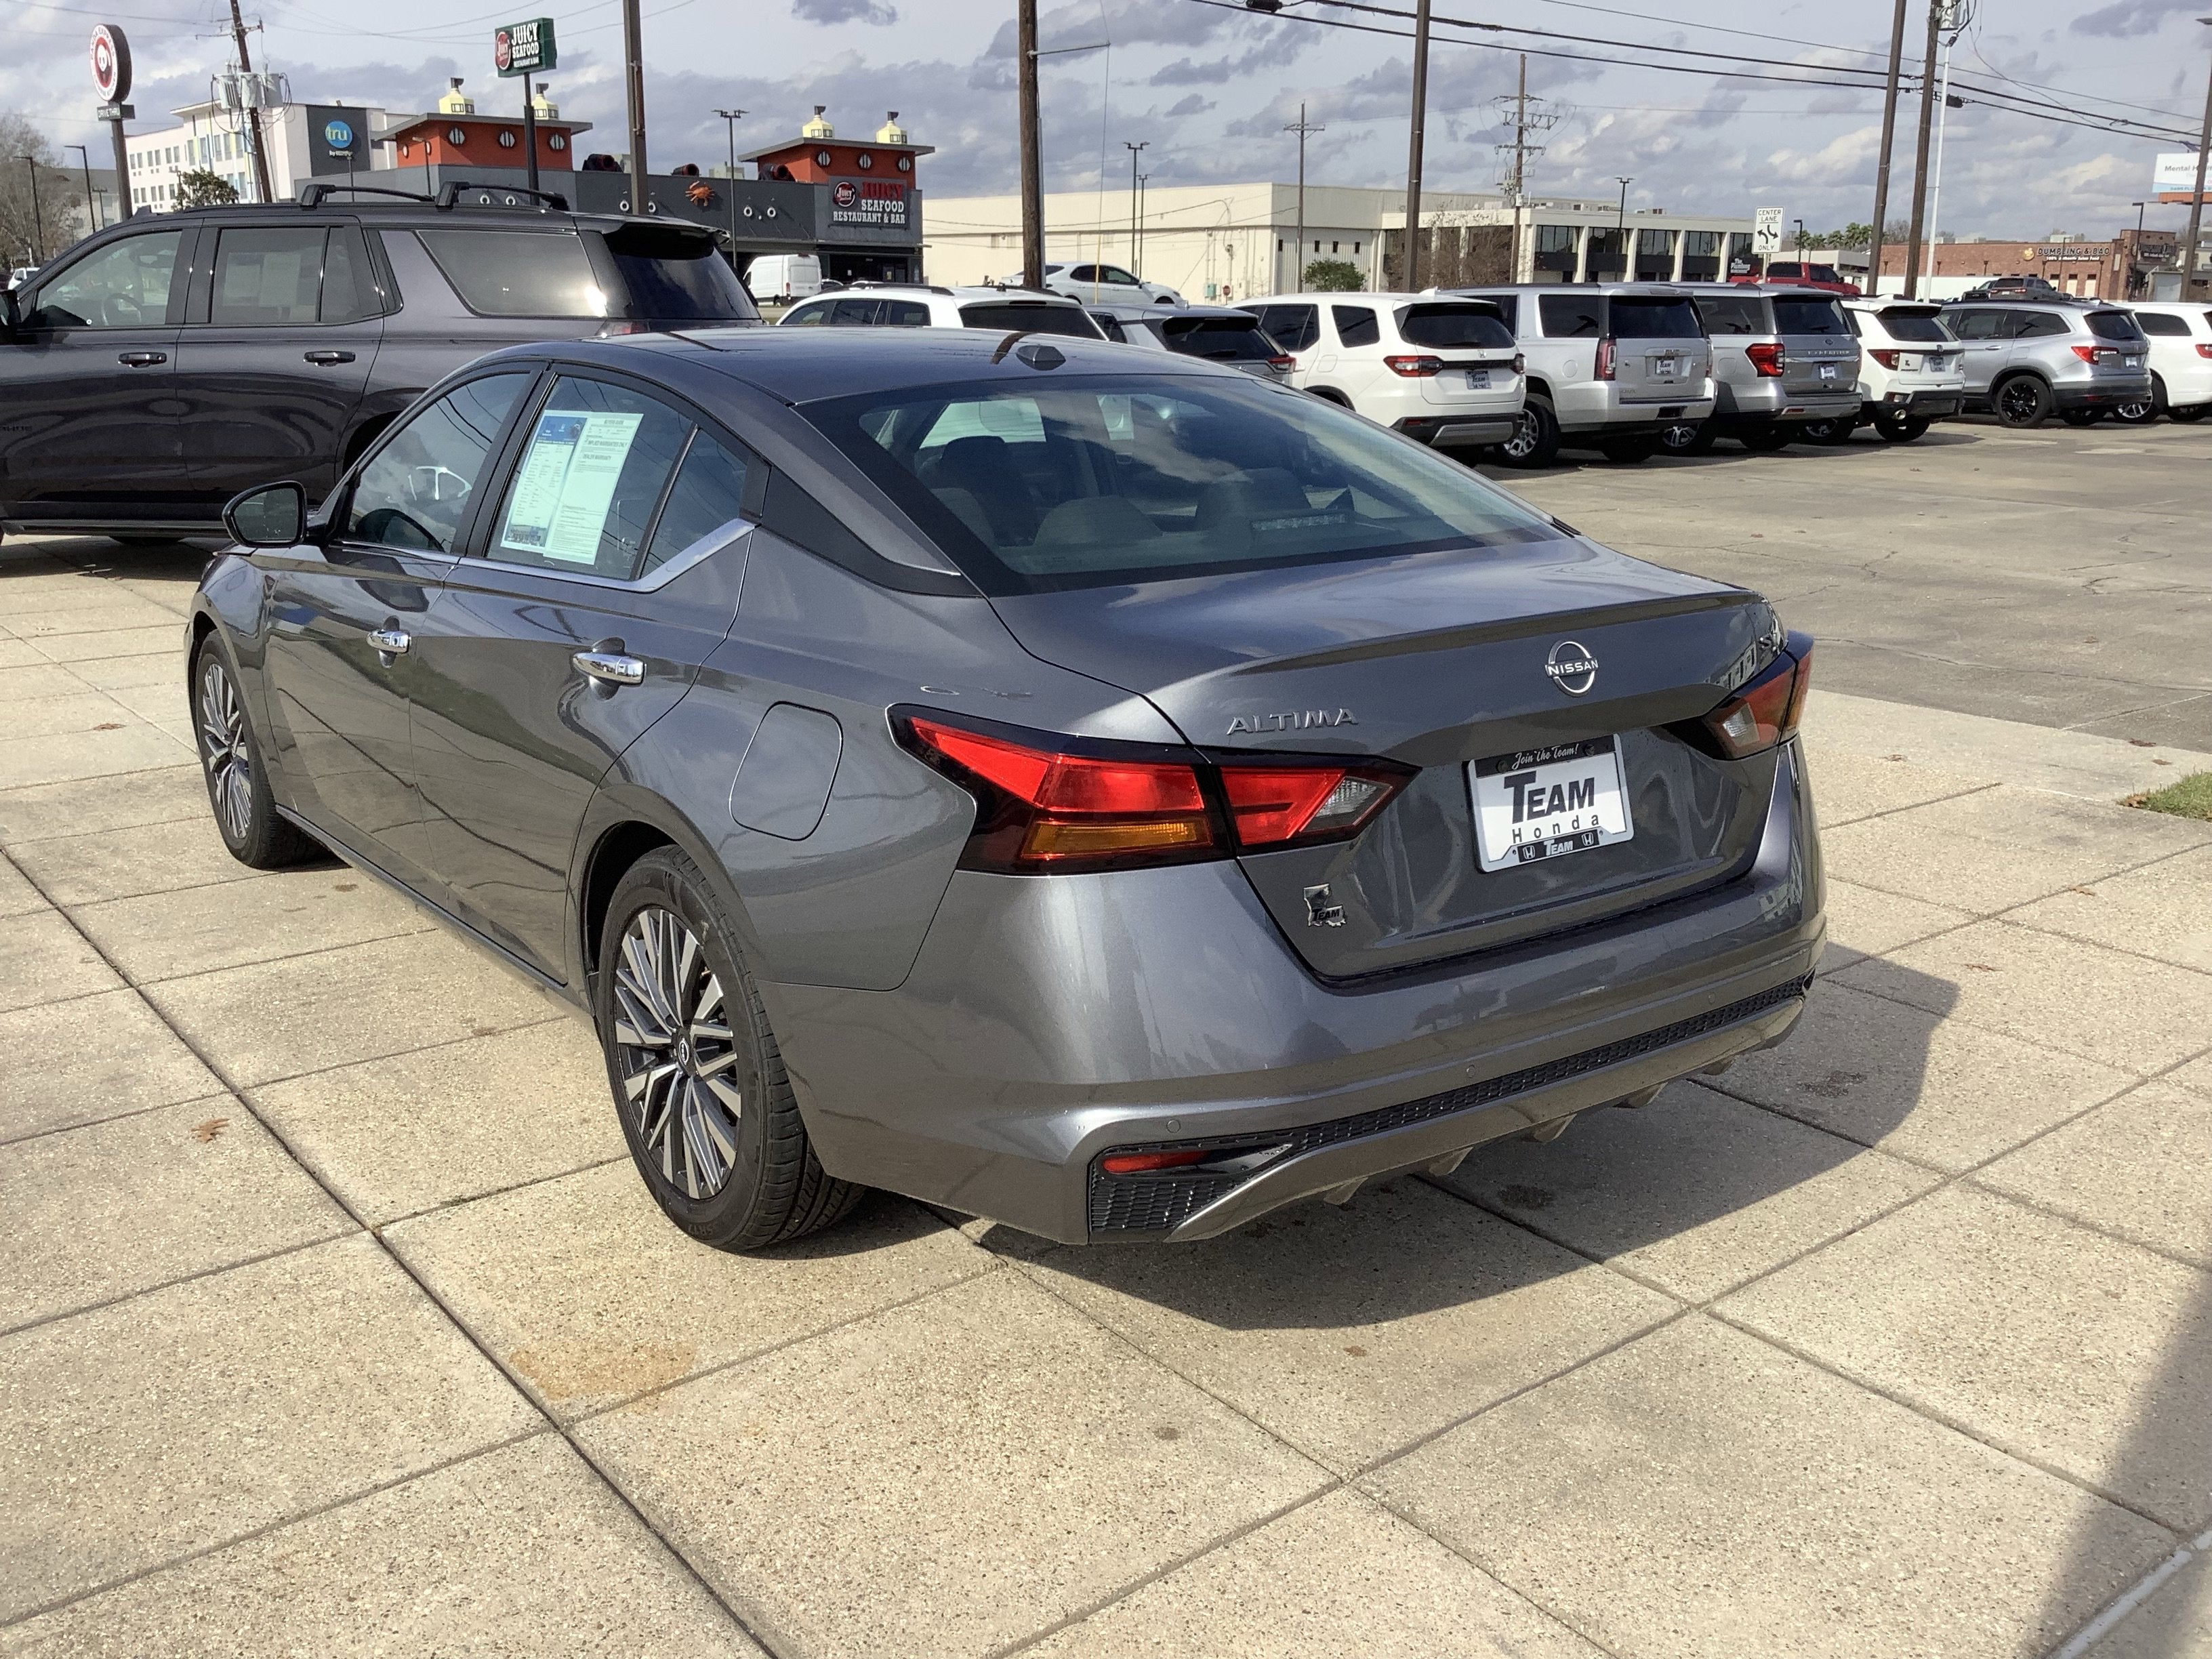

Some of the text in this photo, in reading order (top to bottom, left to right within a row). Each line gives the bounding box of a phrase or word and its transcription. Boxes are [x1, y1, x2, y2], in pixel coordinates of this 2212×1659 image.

[511, 22, 538, 45] JUICY
[512, 41, 539, 59] SEAFOOD
[325, 126, 347, 141] tru
[859, 182, 904, 200] JUICY
[861, 199, 905, 213] SEAFOOD
[833, 211, 905, 224] RESTAURANT & BAR
[2092, 247, 2111, 255] BAO
[1548, 659, 1599, 676] NISSAN
[1225, 708, 1359, 735] ALTIMA
[1511, 743, 1580, 771] Join the Team!
[1503, 770, 1595, 825] TEAM
[1511, 813, 1600, 844] Honda
[1543, 839, 1574, 857] TEAM
[1311, 908, 1340, 922] TEAM
